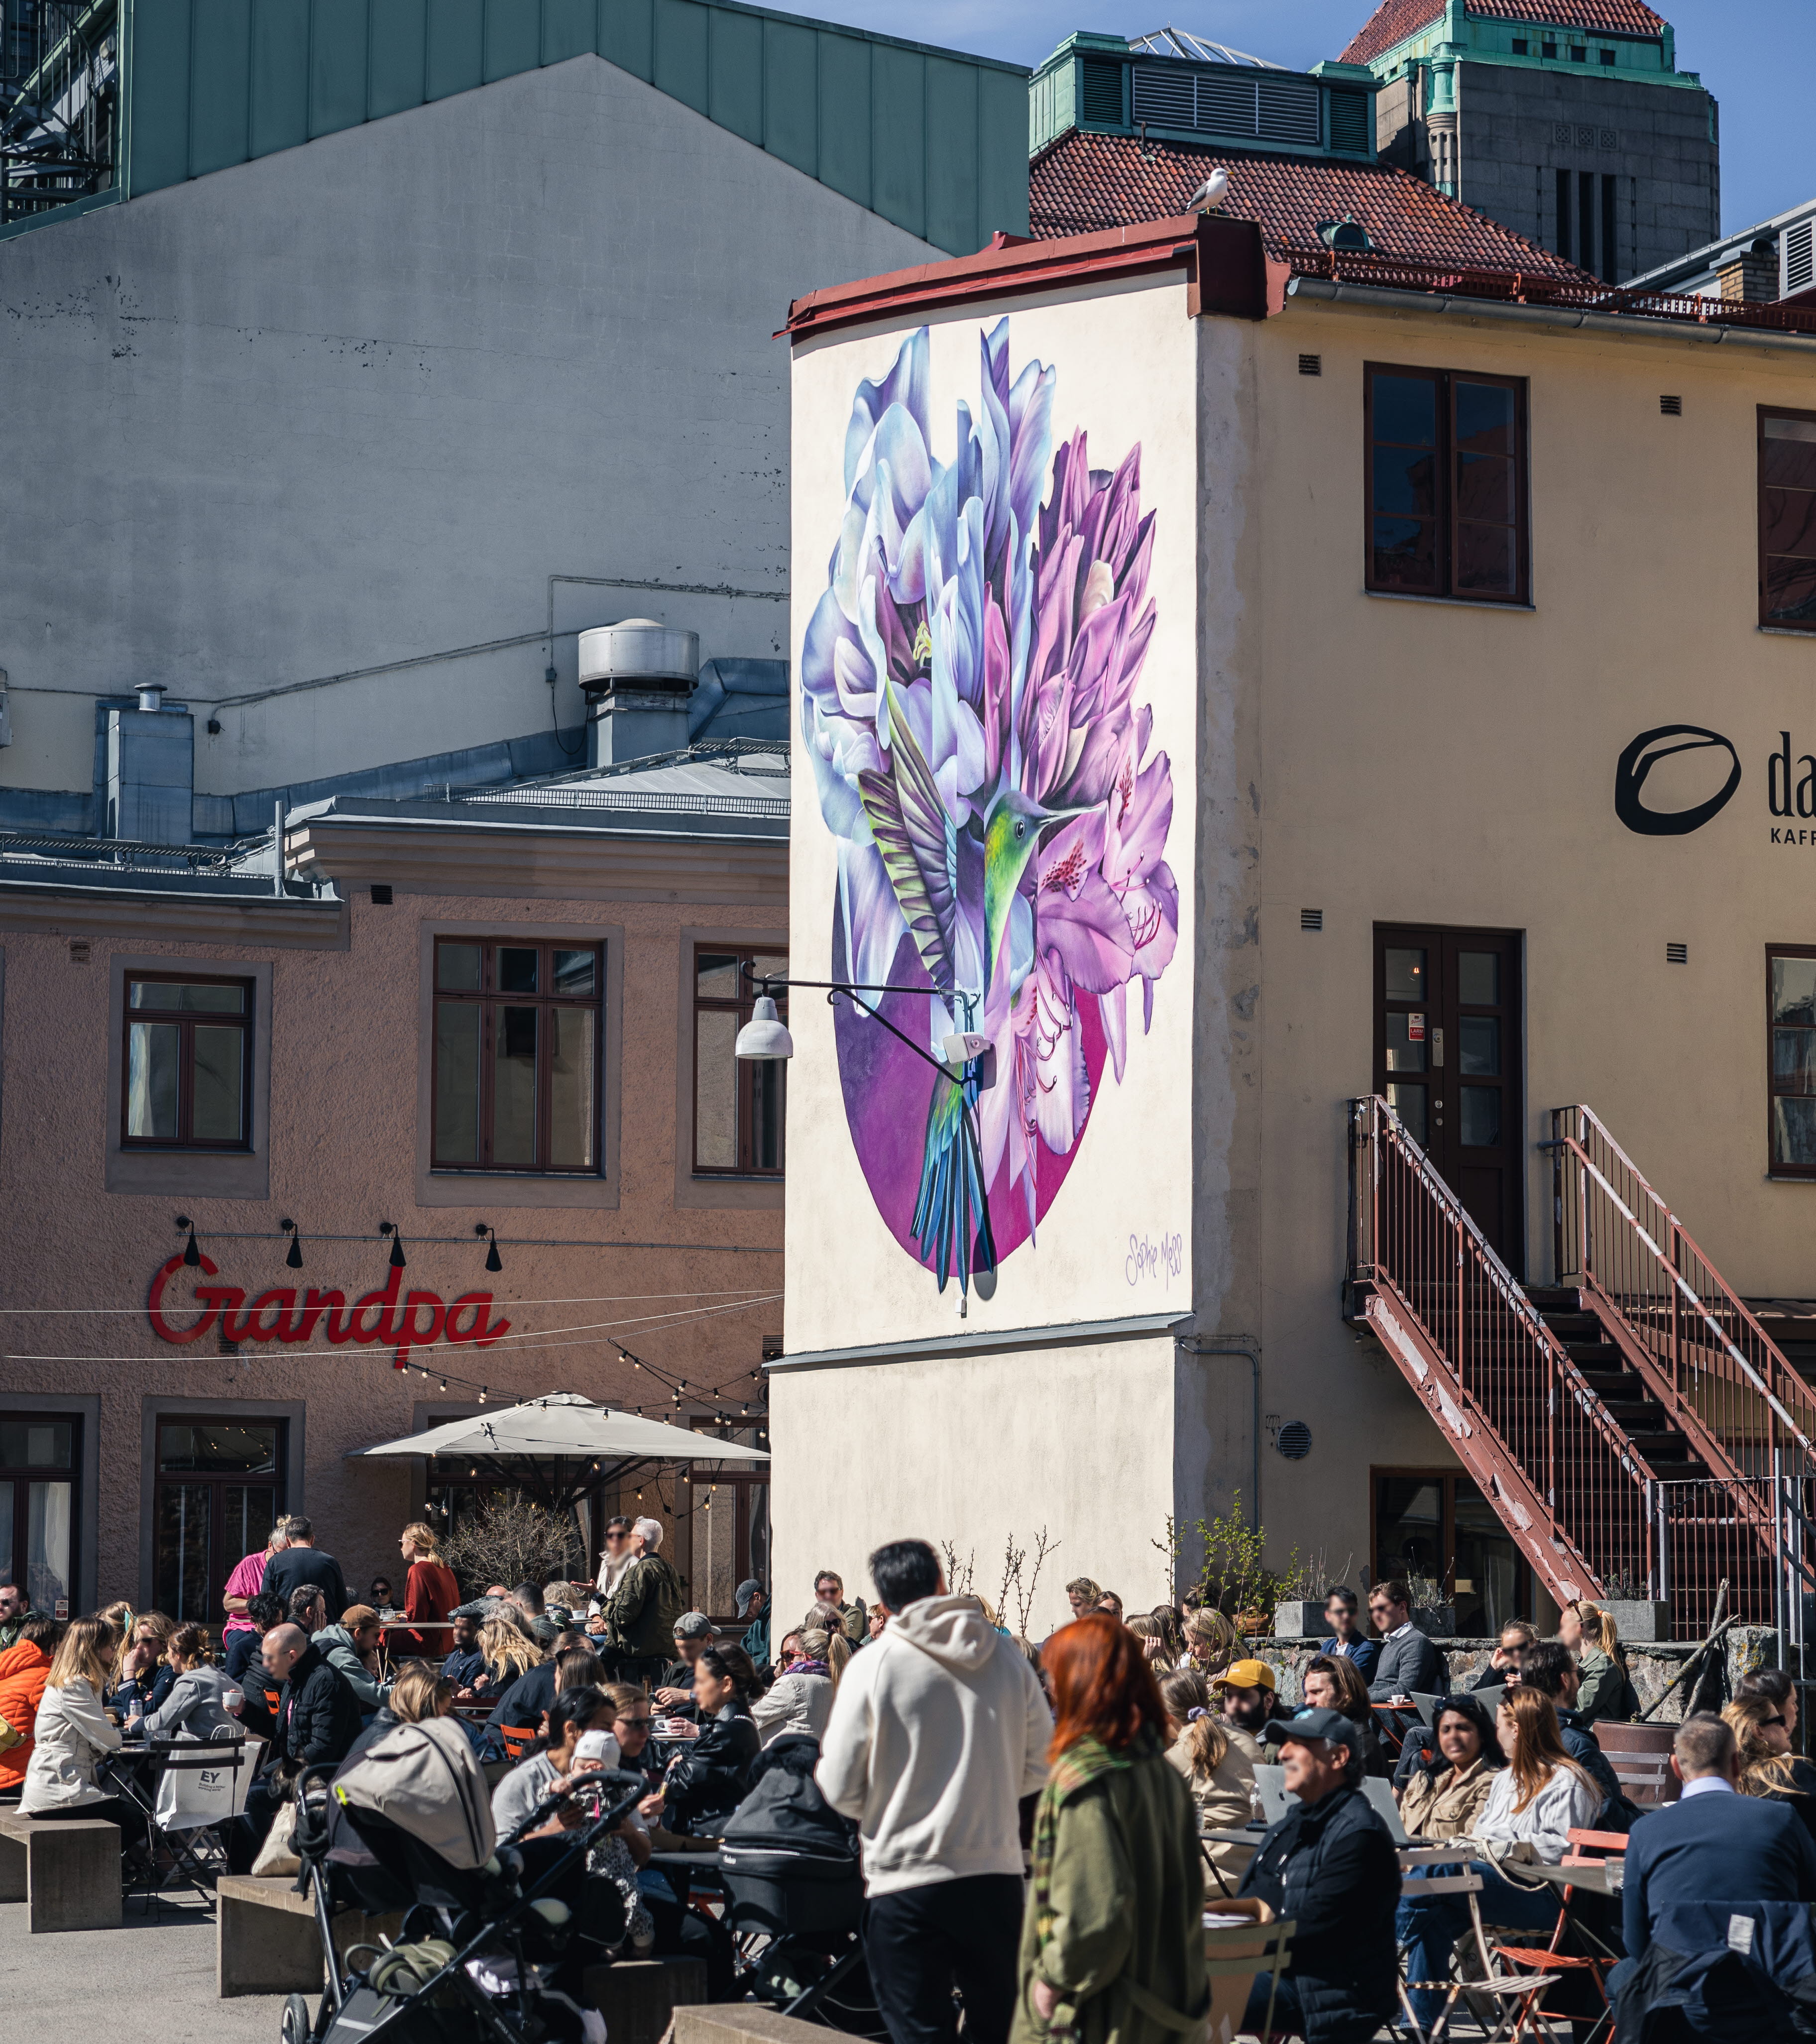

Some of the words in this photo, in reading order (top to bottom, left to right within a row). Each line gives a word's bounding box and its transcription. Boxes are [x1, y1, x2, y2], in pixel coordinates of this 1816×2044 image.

[1768, 731, 1816, 818] da
[1126, 1234, 1157, 1286] Sophie
[149, 1252, 511, 1369] Grandpa
[200, 1770, 221, 1784] EY
